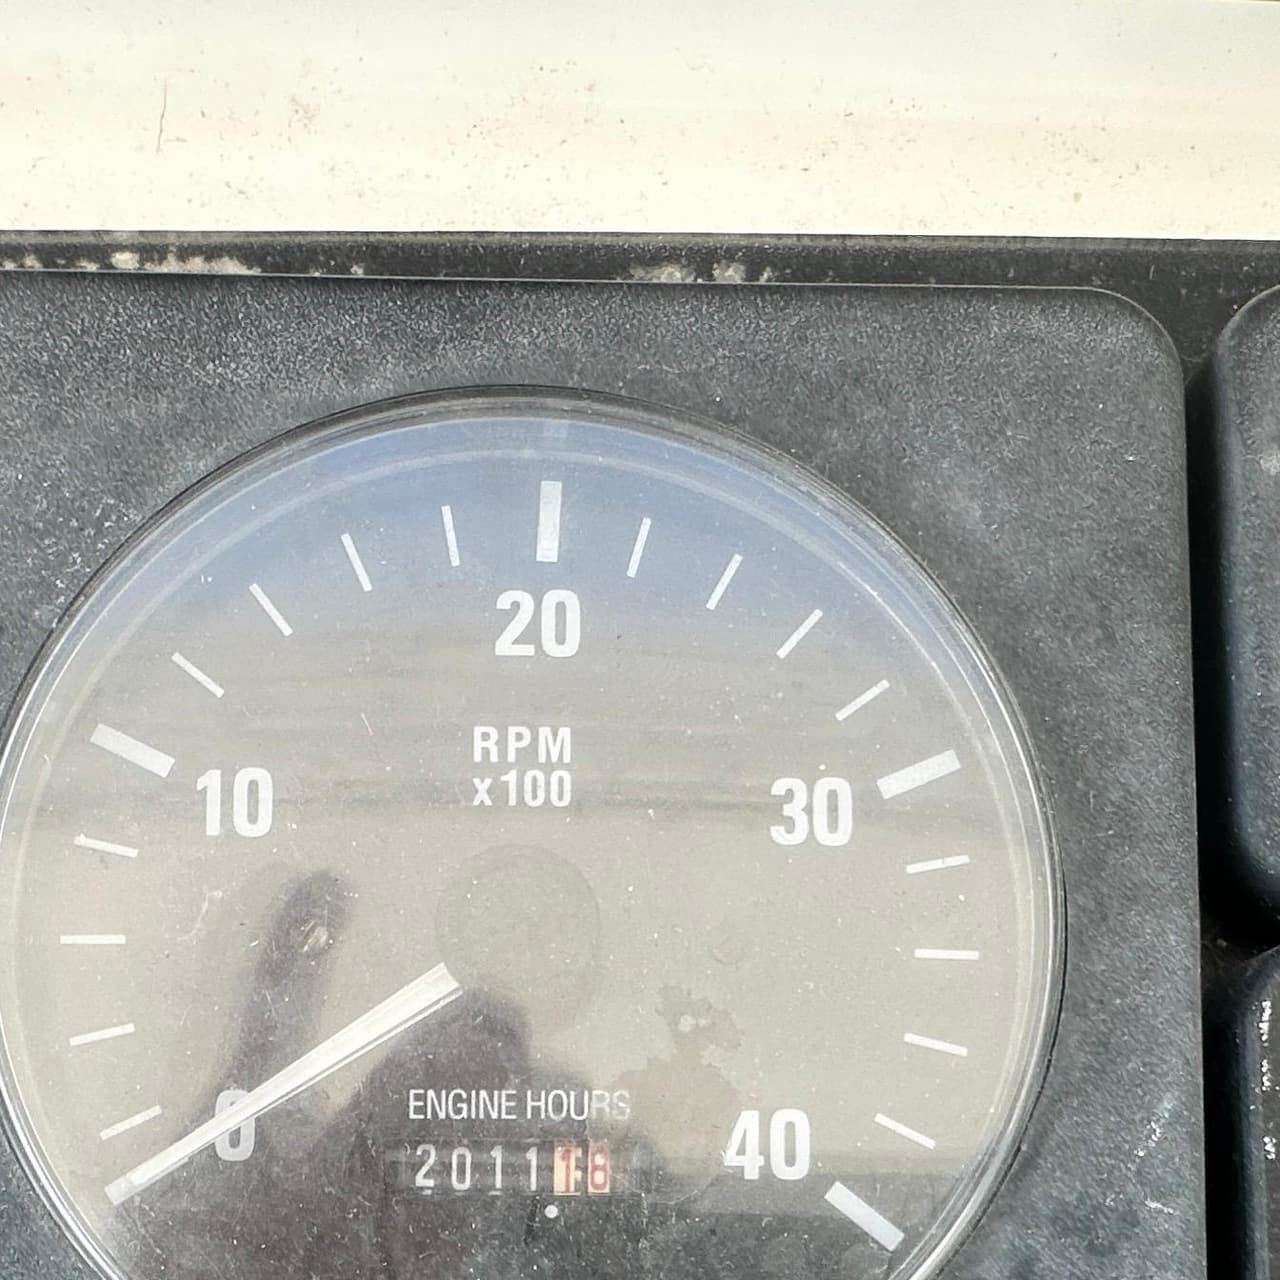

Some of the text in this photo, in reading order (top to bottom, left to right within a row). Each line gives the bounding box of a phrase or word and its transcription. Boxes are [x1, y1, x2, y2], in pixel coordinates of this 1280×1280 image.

[495, 589, 581, 657] 20
[471, 726, 573, 763] RPM
[196, 768, 273, 837] 10
[471, 771, 573, 808] x100
[769, 777, 854, 846] 30
[215, 1088, 256, 1161] 0
[408, 1089, 631, 1121] ENGINE HOURS
[724, 1109, 811, 1181] 40
